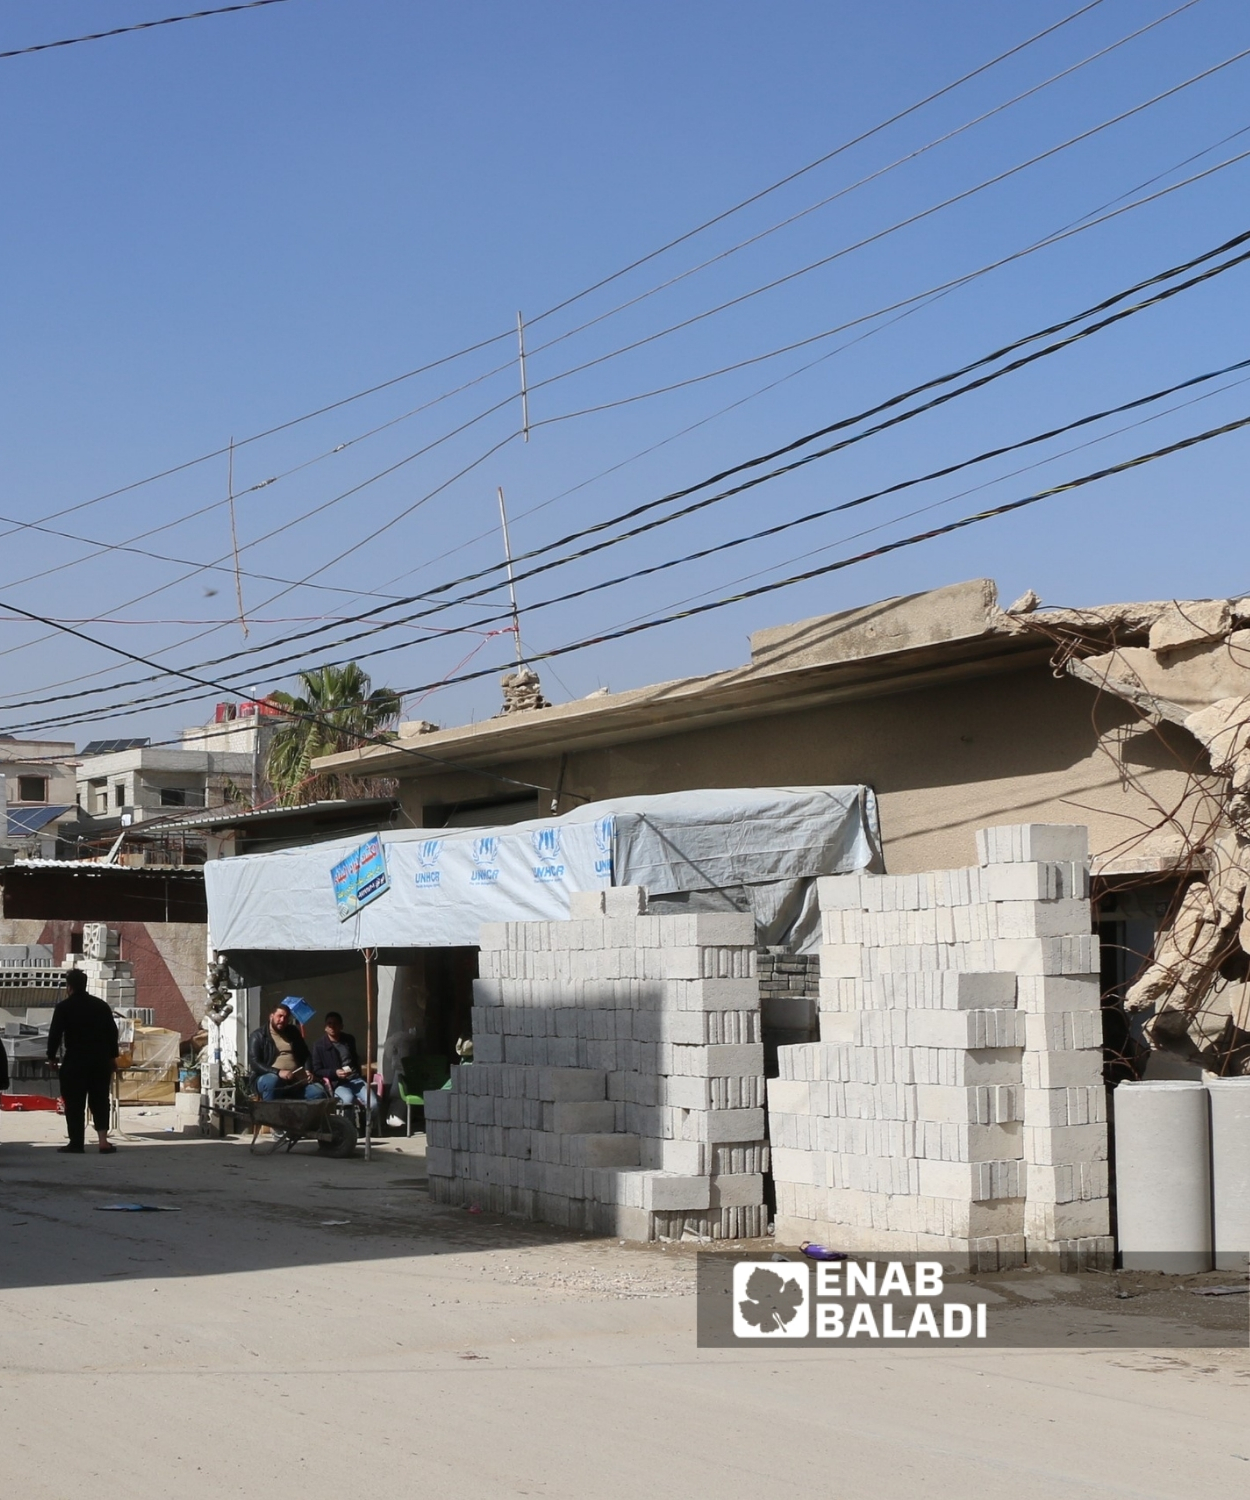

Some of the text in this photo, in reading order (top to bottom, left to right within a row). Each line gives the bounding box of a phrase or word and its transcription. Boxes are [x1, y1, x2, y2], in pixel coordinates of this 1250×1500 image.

[415, 871, 440, 884] UNHCR
[471, 869, 500, 881] UNHCR
[531, 865, 565, 878] UNHCR
